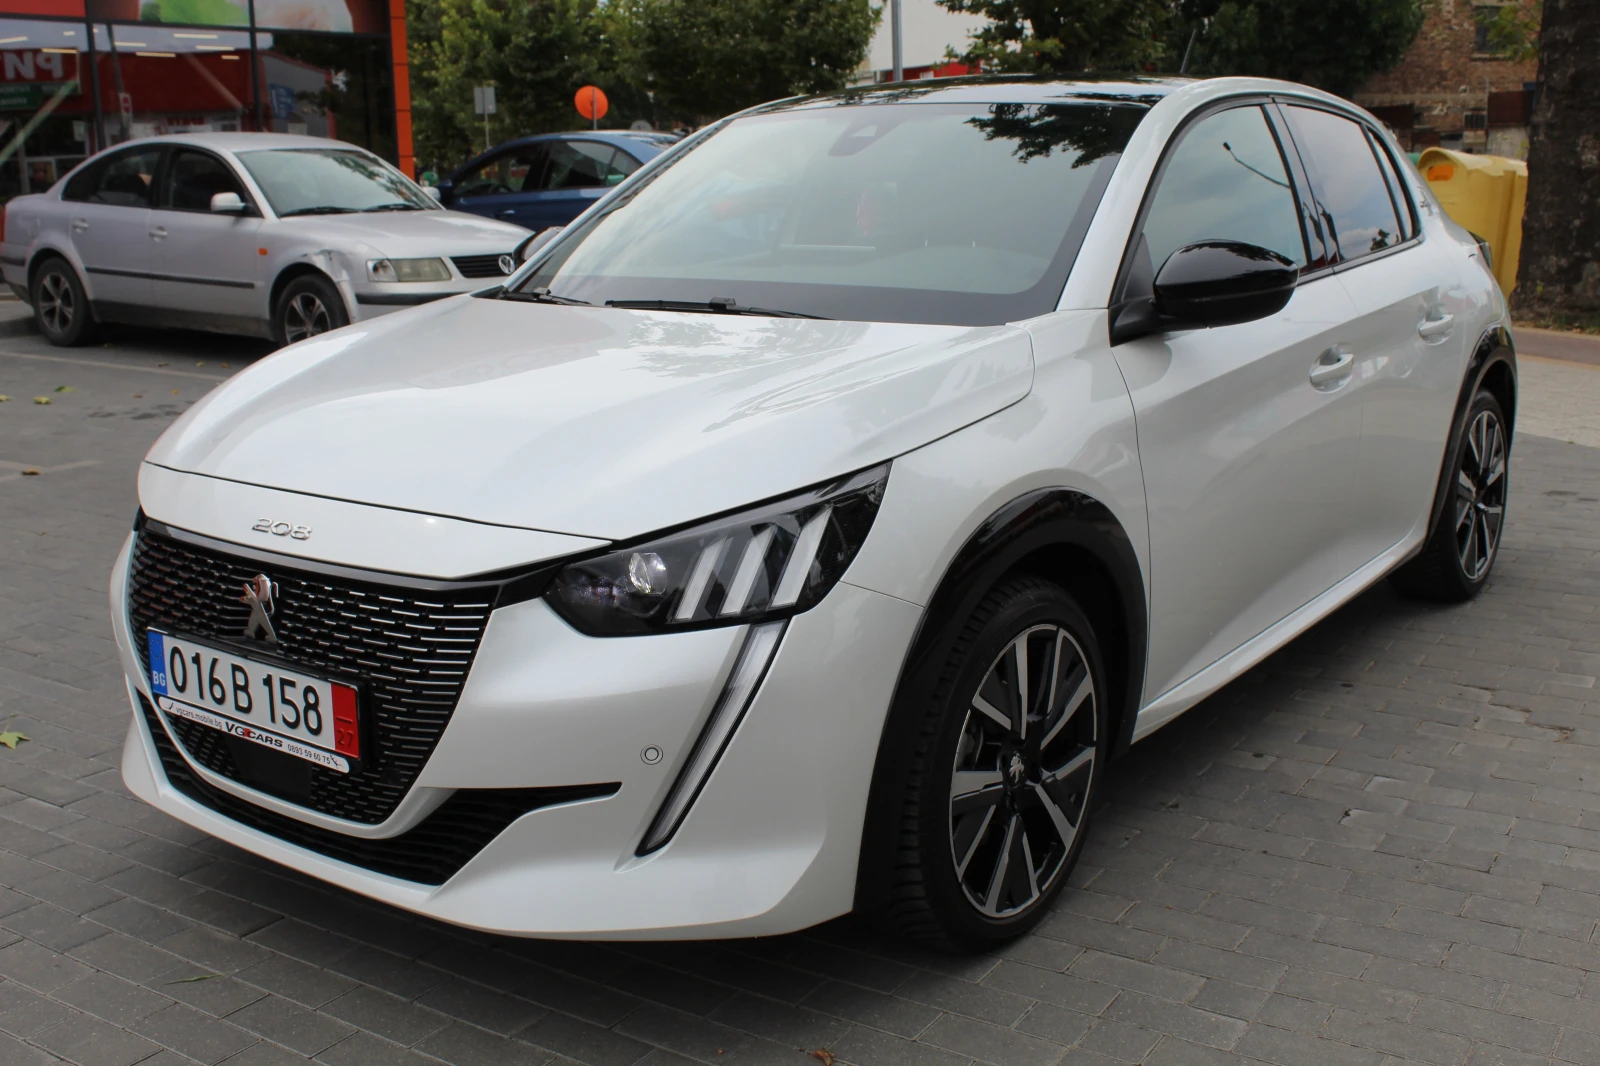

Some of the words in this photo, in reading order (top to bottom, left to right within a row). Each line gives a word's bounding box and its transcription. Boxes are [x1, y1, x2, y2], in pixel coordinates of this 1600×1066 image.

[252, 517, 312, 541] 208
[153, 671, 166, 687] BG
[175, 707, 222, 730] vgcars.mobile.bg
[322, 756, 331, 765] 75
[338, 728, 354, 748] 27
